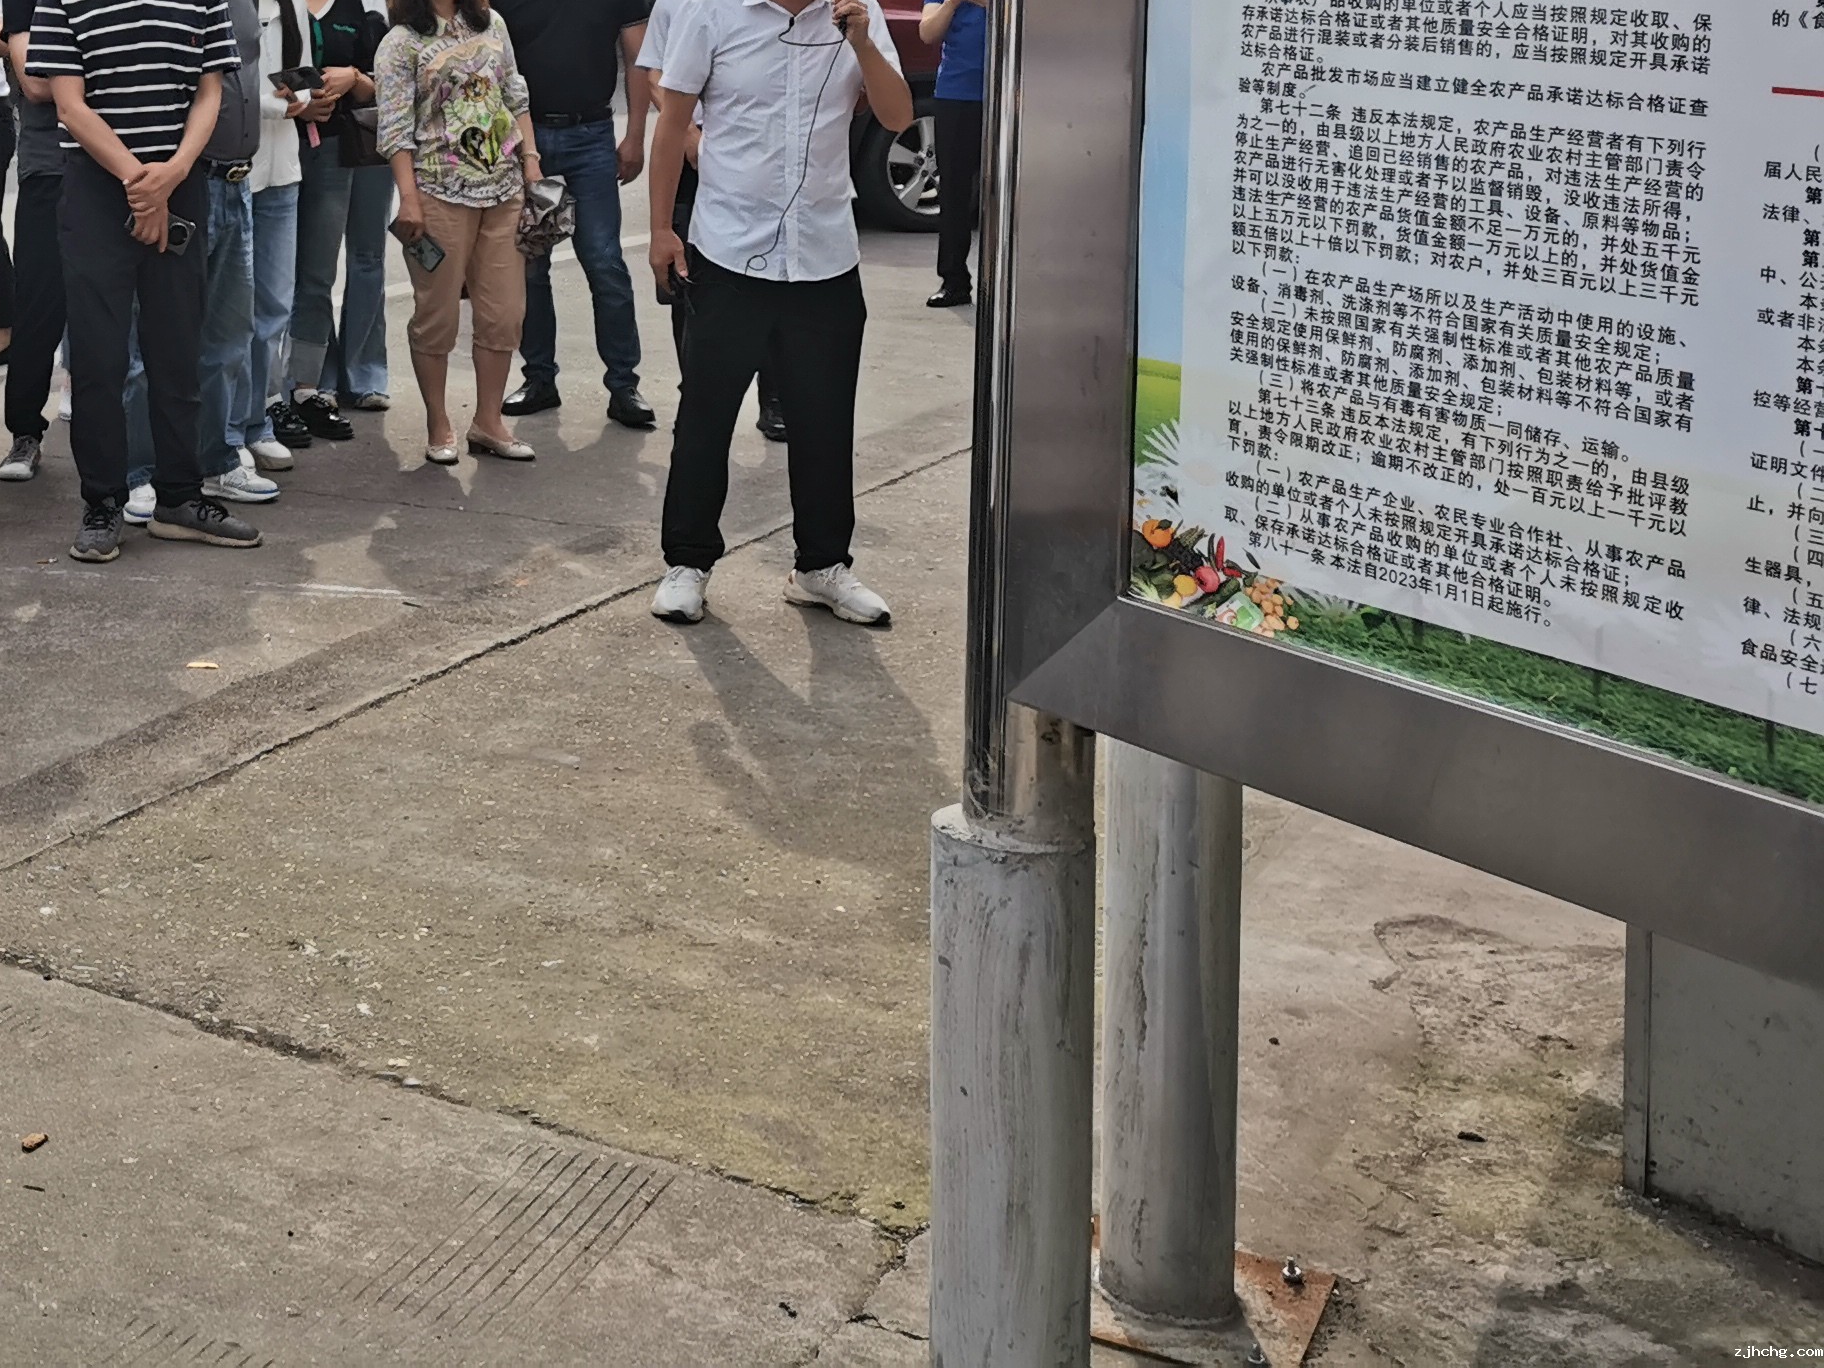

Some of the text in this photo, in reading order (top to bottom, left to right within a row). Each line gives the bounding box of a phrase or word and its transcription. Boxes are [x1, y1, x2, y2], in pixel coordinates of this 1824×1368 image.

[1239, 39, 1324, 64] 达标合格证。
[1237, 75, 1307, 100] 验等制度。
[1258, 95, 1342, 121] 第七十二条
[1763, 161, 1823, 183] 届人民
[1232, 238, 1300, 264] 以下罚款：
[1760, 265, 1824, 290] 中、公
[1798, 292, 1824, 312] 本
[1256, 386, 1336, 419] 第七十三条
[1226, 433, 1279, 462] 下罚款：
[1247, 528, 1326, 566] 第八十一条
[1740, 637, 1824, 675] 食品安全
